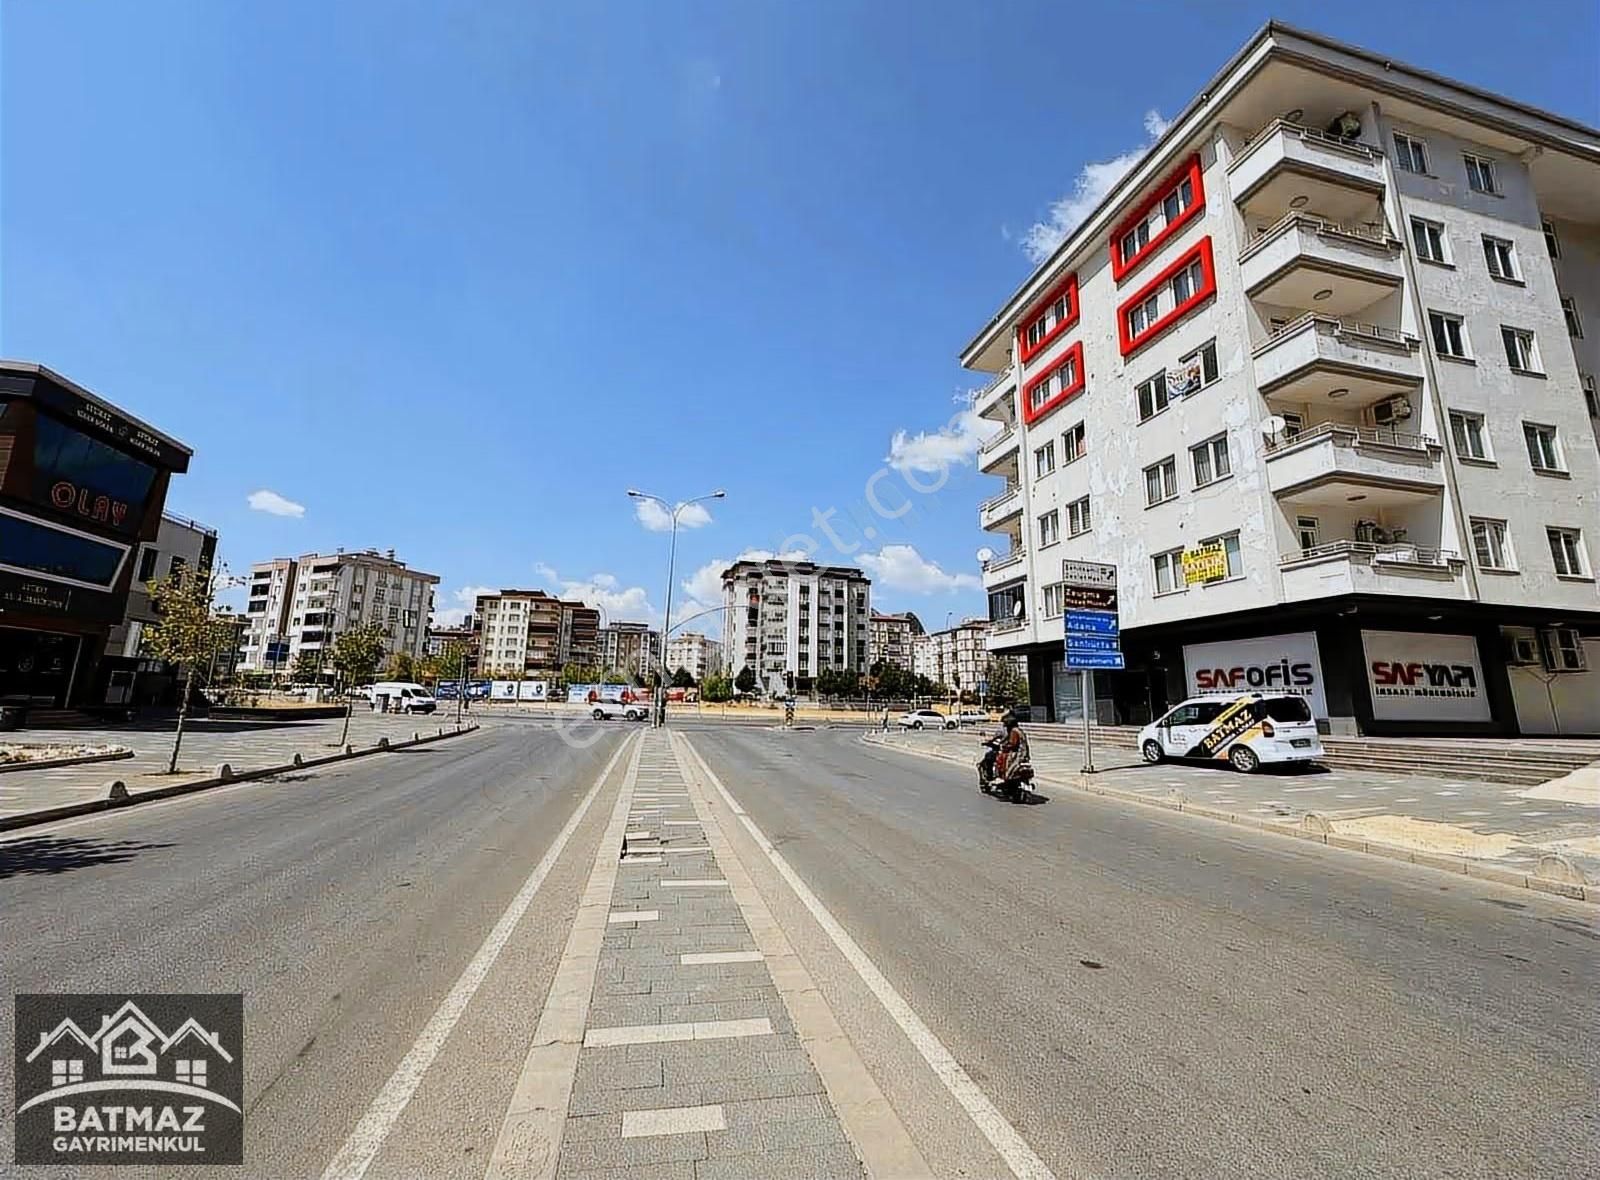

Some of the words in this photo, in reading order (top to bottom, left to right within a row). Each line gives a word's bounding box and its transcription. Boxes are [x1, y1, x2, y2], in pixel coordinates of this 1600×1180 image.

[50, 481, 128, 526] OLAY
[1067, 621, 1096, 631] Adana
[1203, 708, 1253, 749] BATMAZ
